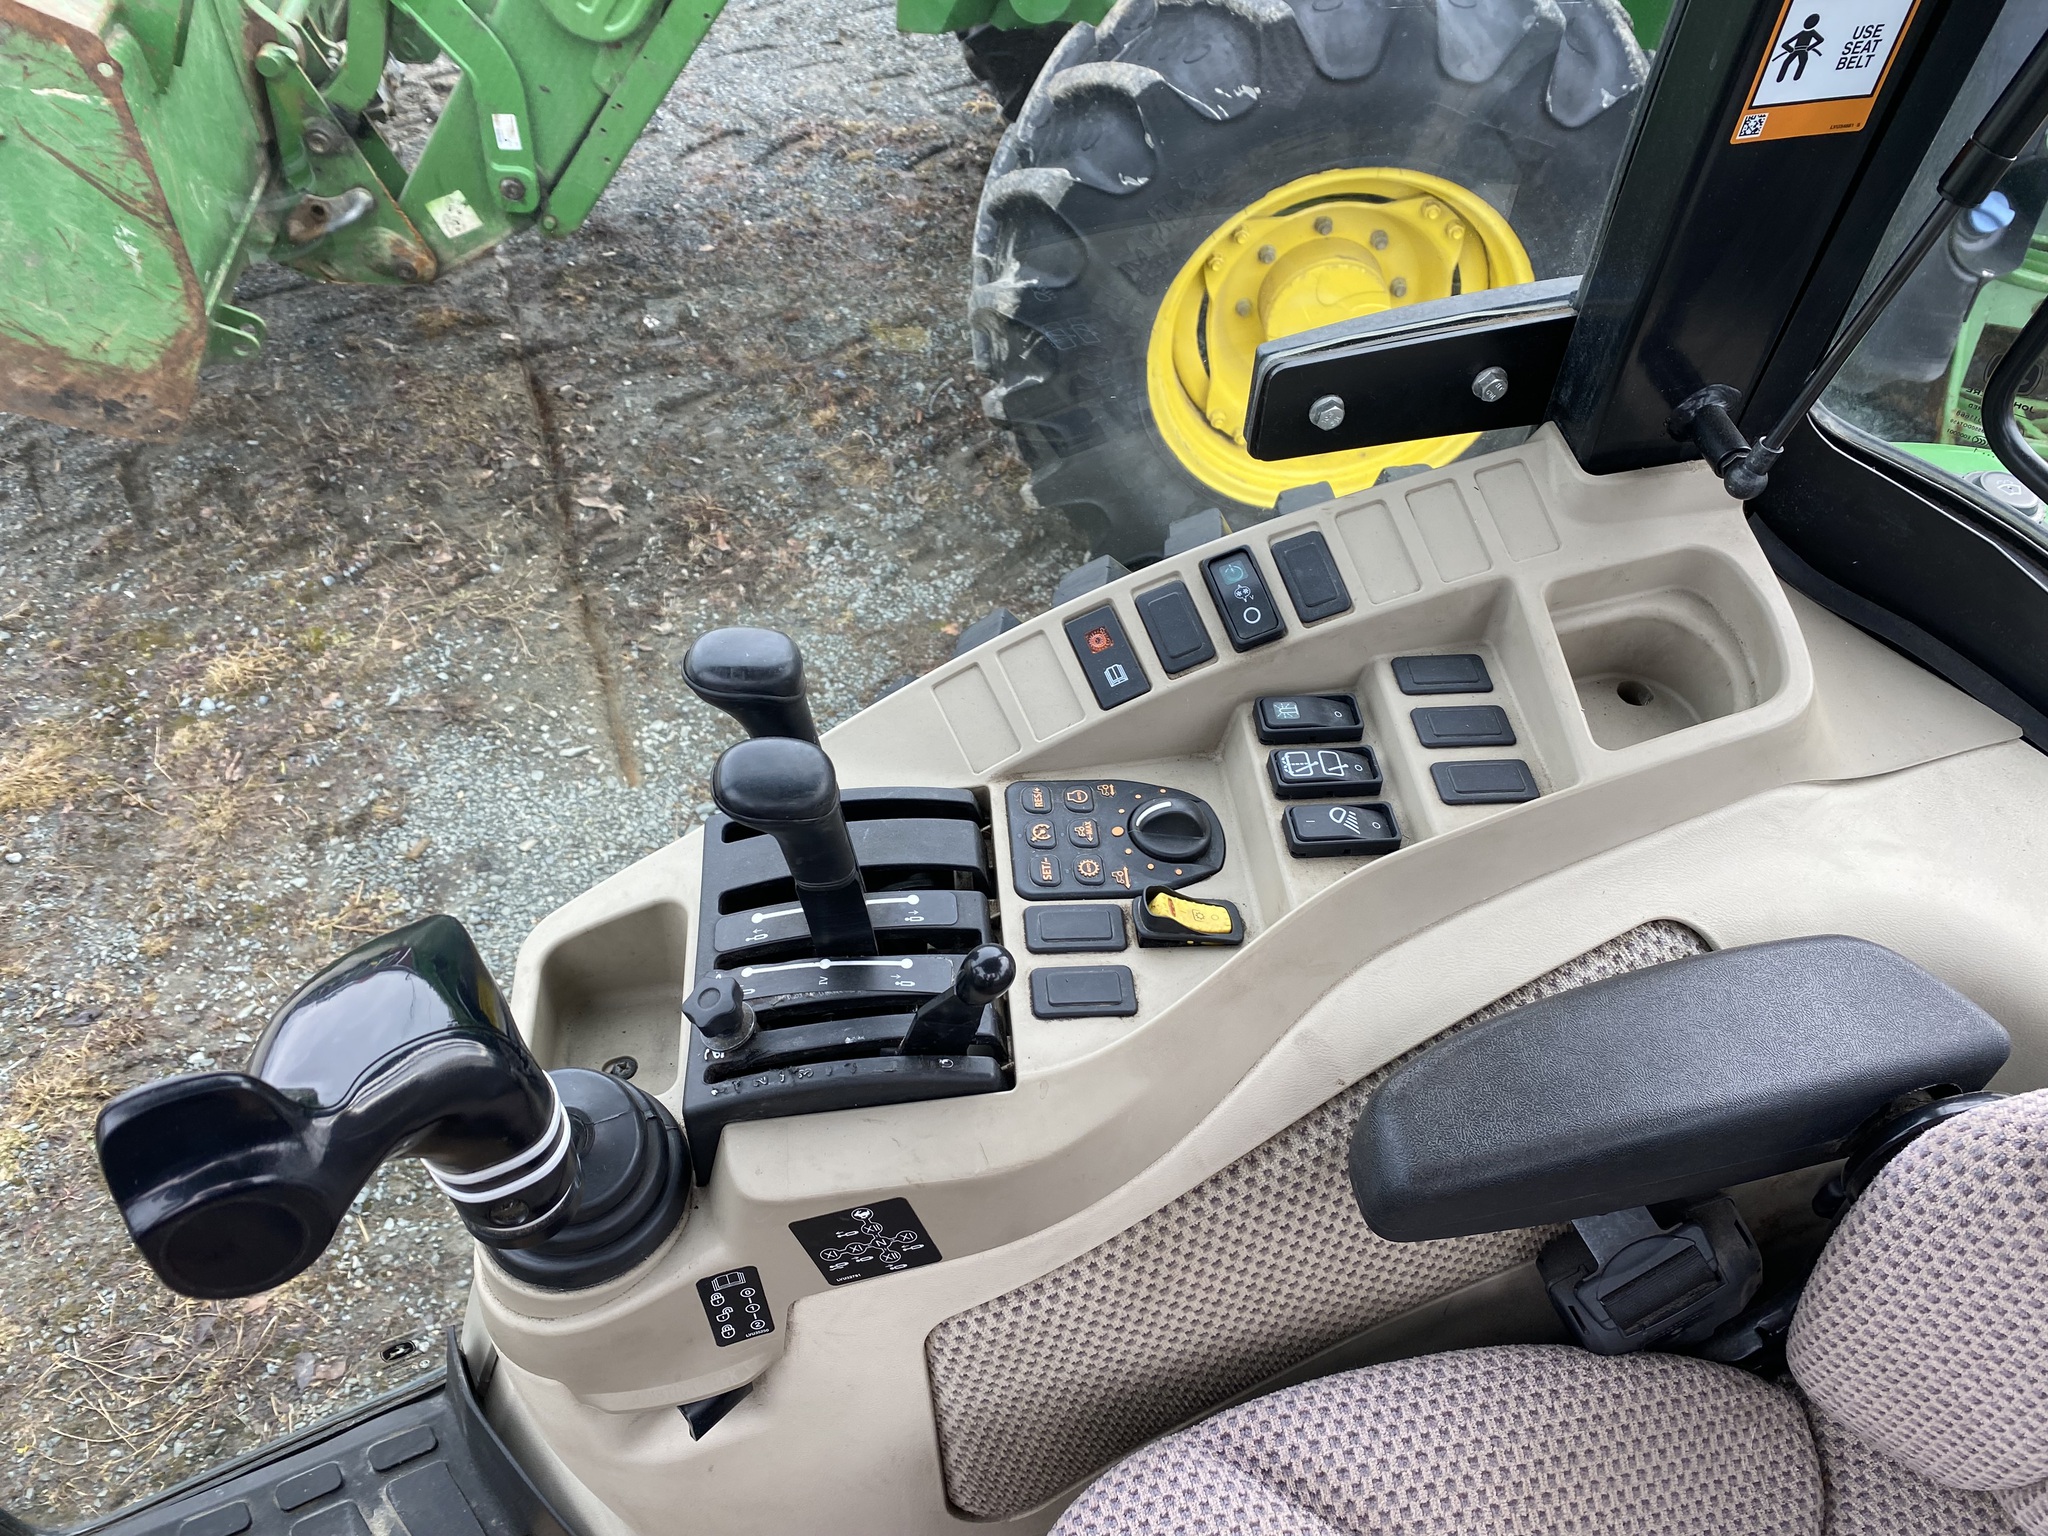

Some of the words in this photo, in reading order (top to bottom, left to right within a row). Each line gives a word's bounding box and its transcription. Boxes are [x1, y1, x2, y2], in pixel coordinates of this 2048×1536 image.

[1852, 23, 1885, 40] USE
[1841, 39, 1883, 56] SEAT
[1835, 54, 1876, 71] BELT
[1033, 787, 1045, 809] RES/+
[1084, 821, 1093, 835] MAX
[863, 1224, 881, 1234] XII
[900, 1232, 914, 1242] XI
[875, 1238, 887, 1247] N
[849, 1244, 863, 1253] XI
[823, 1250, 838, 1259] XI
[883, 1252, 899, 1261] XII
